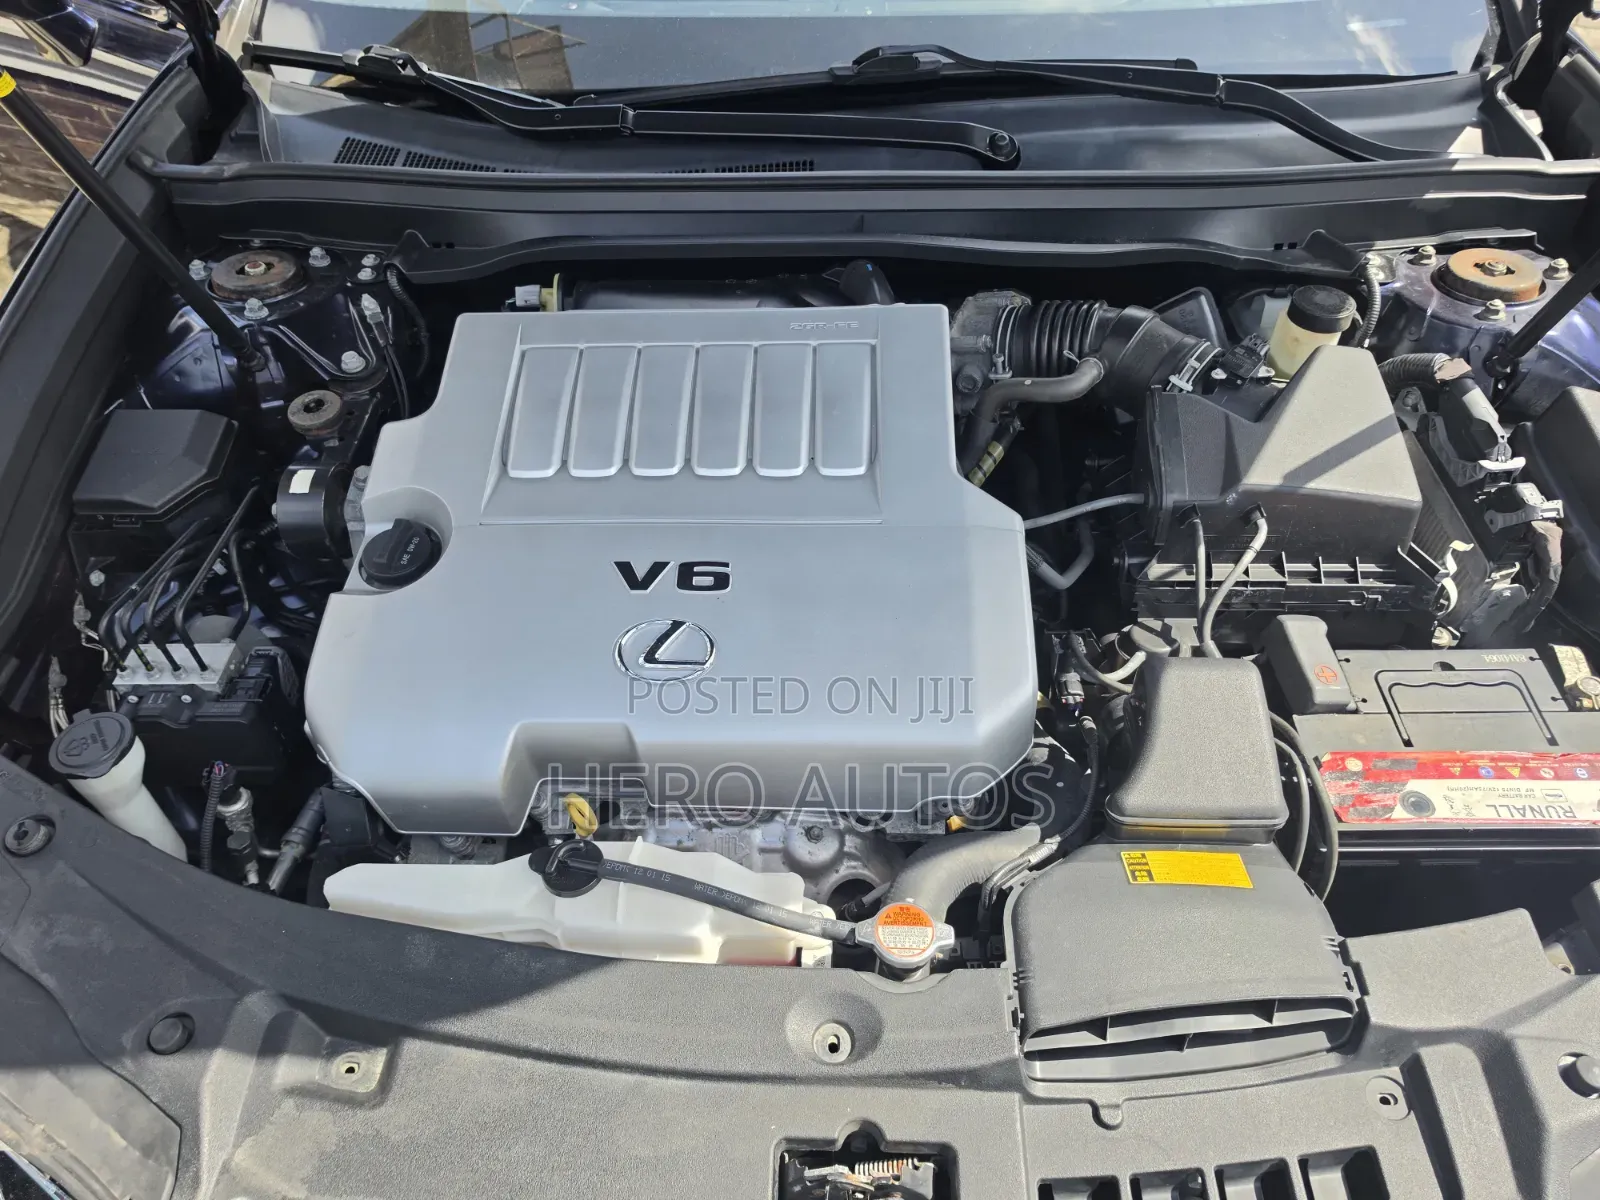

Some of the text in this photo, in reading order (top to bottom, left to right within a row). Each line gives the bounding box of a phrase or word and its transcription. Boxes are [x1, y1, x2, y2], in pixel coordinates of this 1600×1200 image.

[790, 321, 859, 331] 2GR-FE
[400, 554, 410, 564] SAE
[611, 560, 733, 595] V6
[1485, 804, 1577, 818] RUNALL
[634, 867, 644, 876] 12
[647, 870, 656, 879] 01
[694, 882, 718, 896] WATER
[809, 918, 832, 928] WATER
